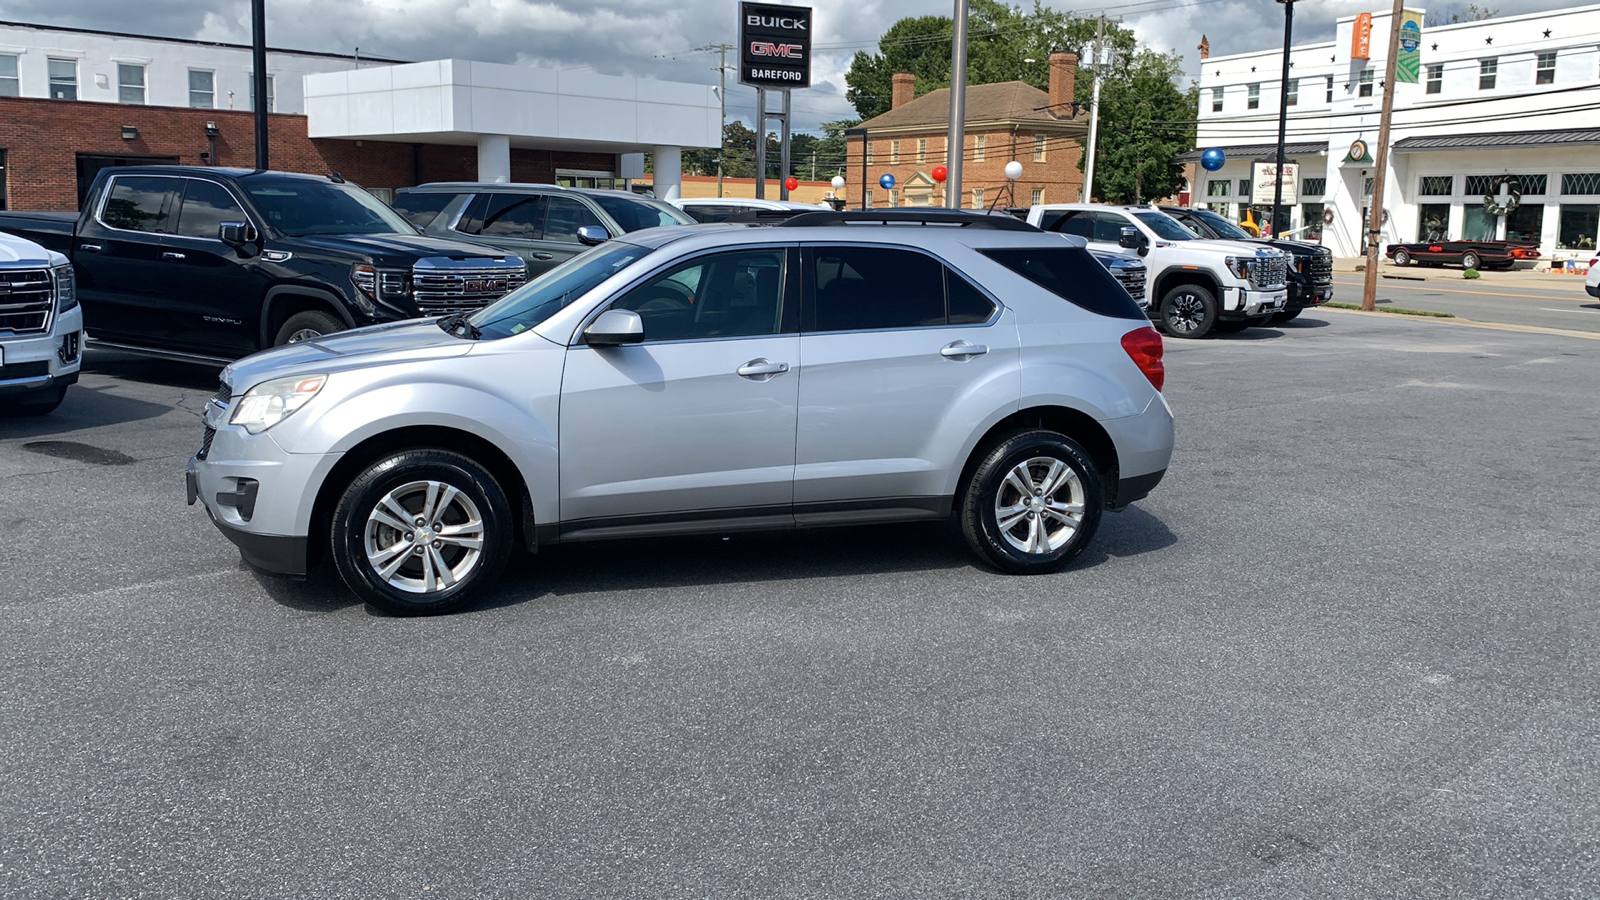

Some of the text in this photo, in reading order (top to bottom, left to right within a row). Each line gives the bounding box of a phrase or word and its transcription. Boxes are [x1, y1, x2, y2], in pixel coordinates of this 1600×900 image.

[747, 15, 807, 30] BUICK
[1360, 16, 1369, 56] ACME
[750, 41, 803, 59] GMC
[751, 68, 802, 81] BAREFORD
[465, 280, 507, 291] GMC
